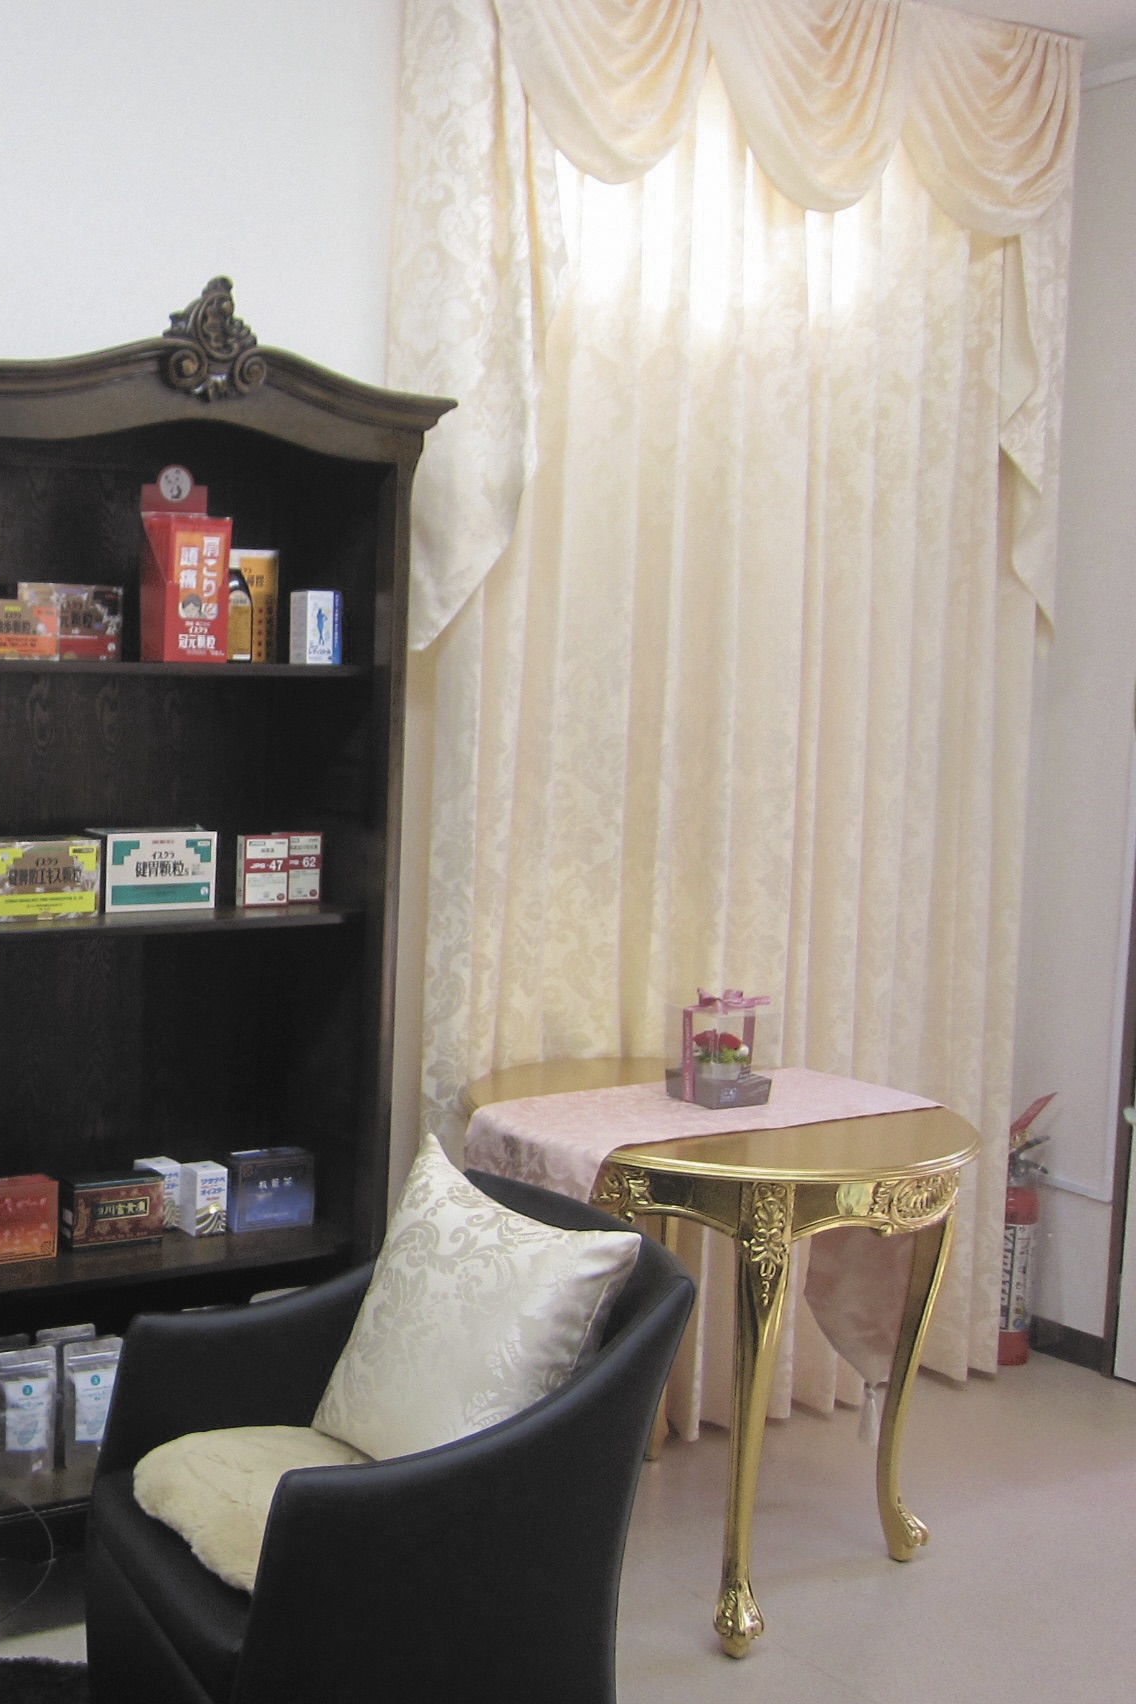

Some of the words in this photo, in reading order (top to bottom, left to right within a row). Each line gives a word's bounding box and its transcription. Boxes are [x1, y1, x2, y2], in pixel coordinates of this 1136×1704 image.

[179, 546, 199, 589] 頭痛
[202, 536, 221, 598] 肩こり
[152, 851, 175, 860] イスクラ
